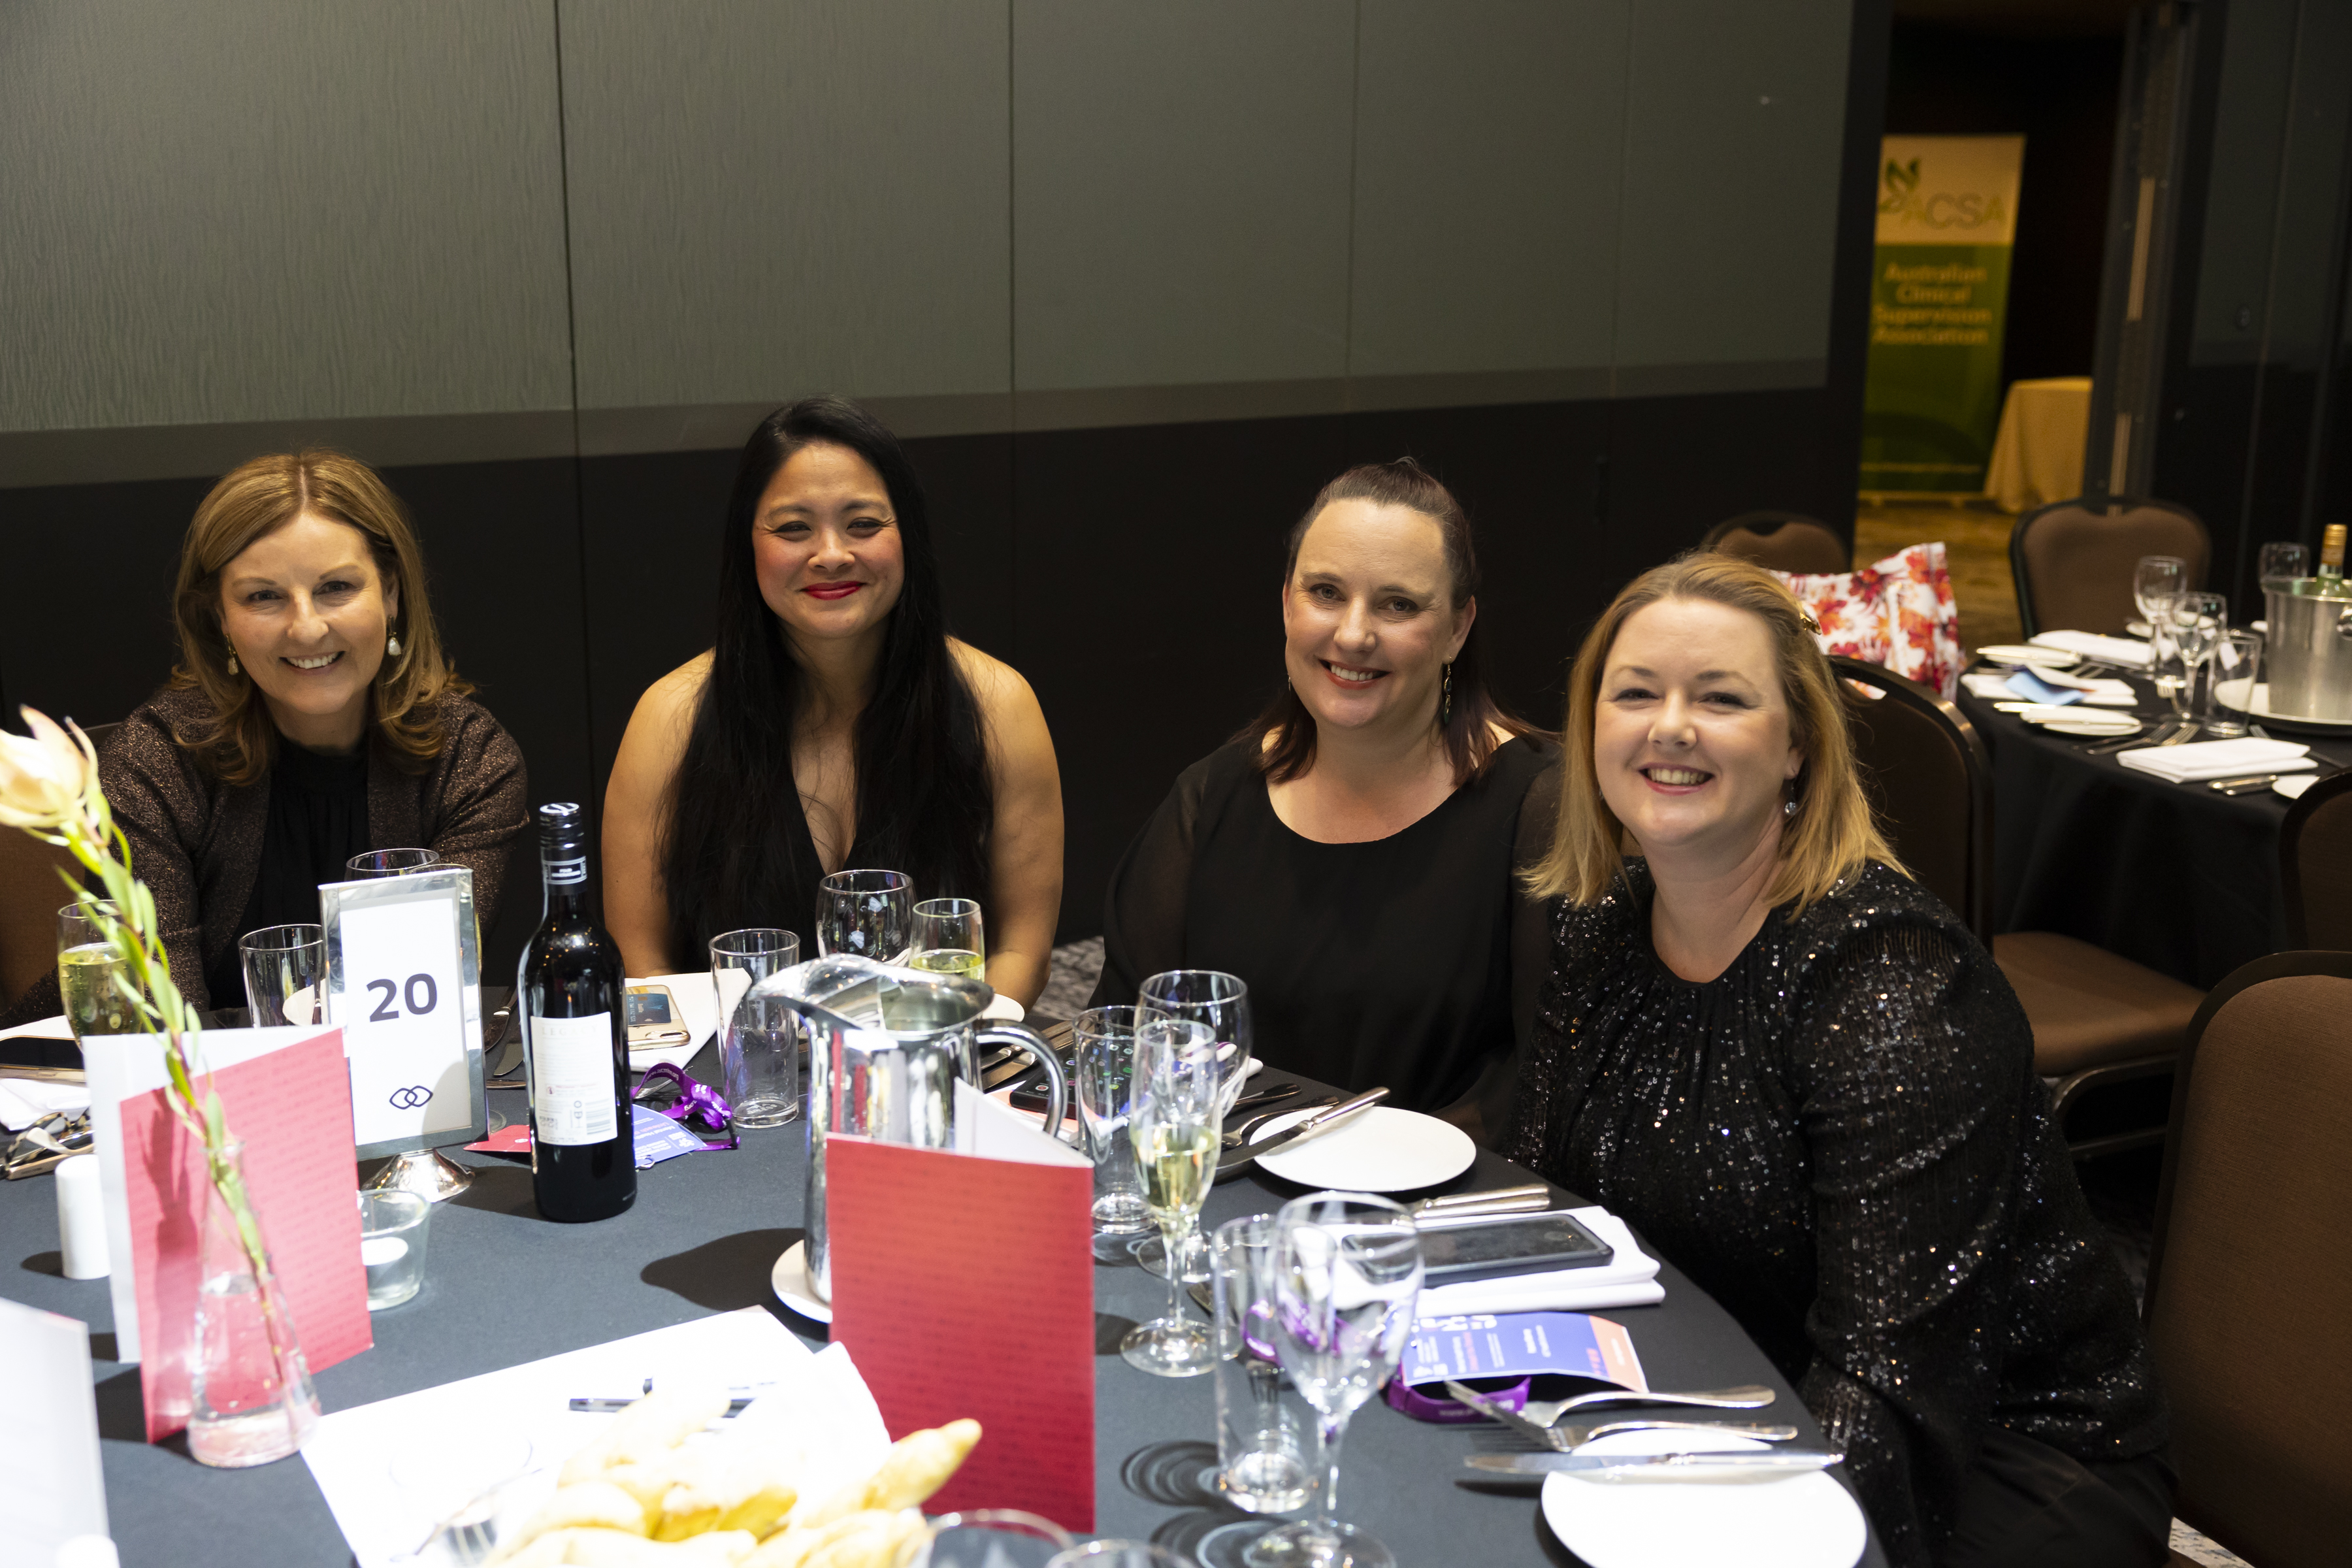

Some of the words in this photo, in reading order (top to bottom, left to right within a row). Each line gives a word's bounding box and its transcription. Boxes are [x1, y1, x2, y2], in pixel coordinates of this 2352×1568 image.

[1901, 193, 2006, 229] ACSA
[367, 973, 436, 1021] 20
[542, 1025, 597, 1036] LEGACY
